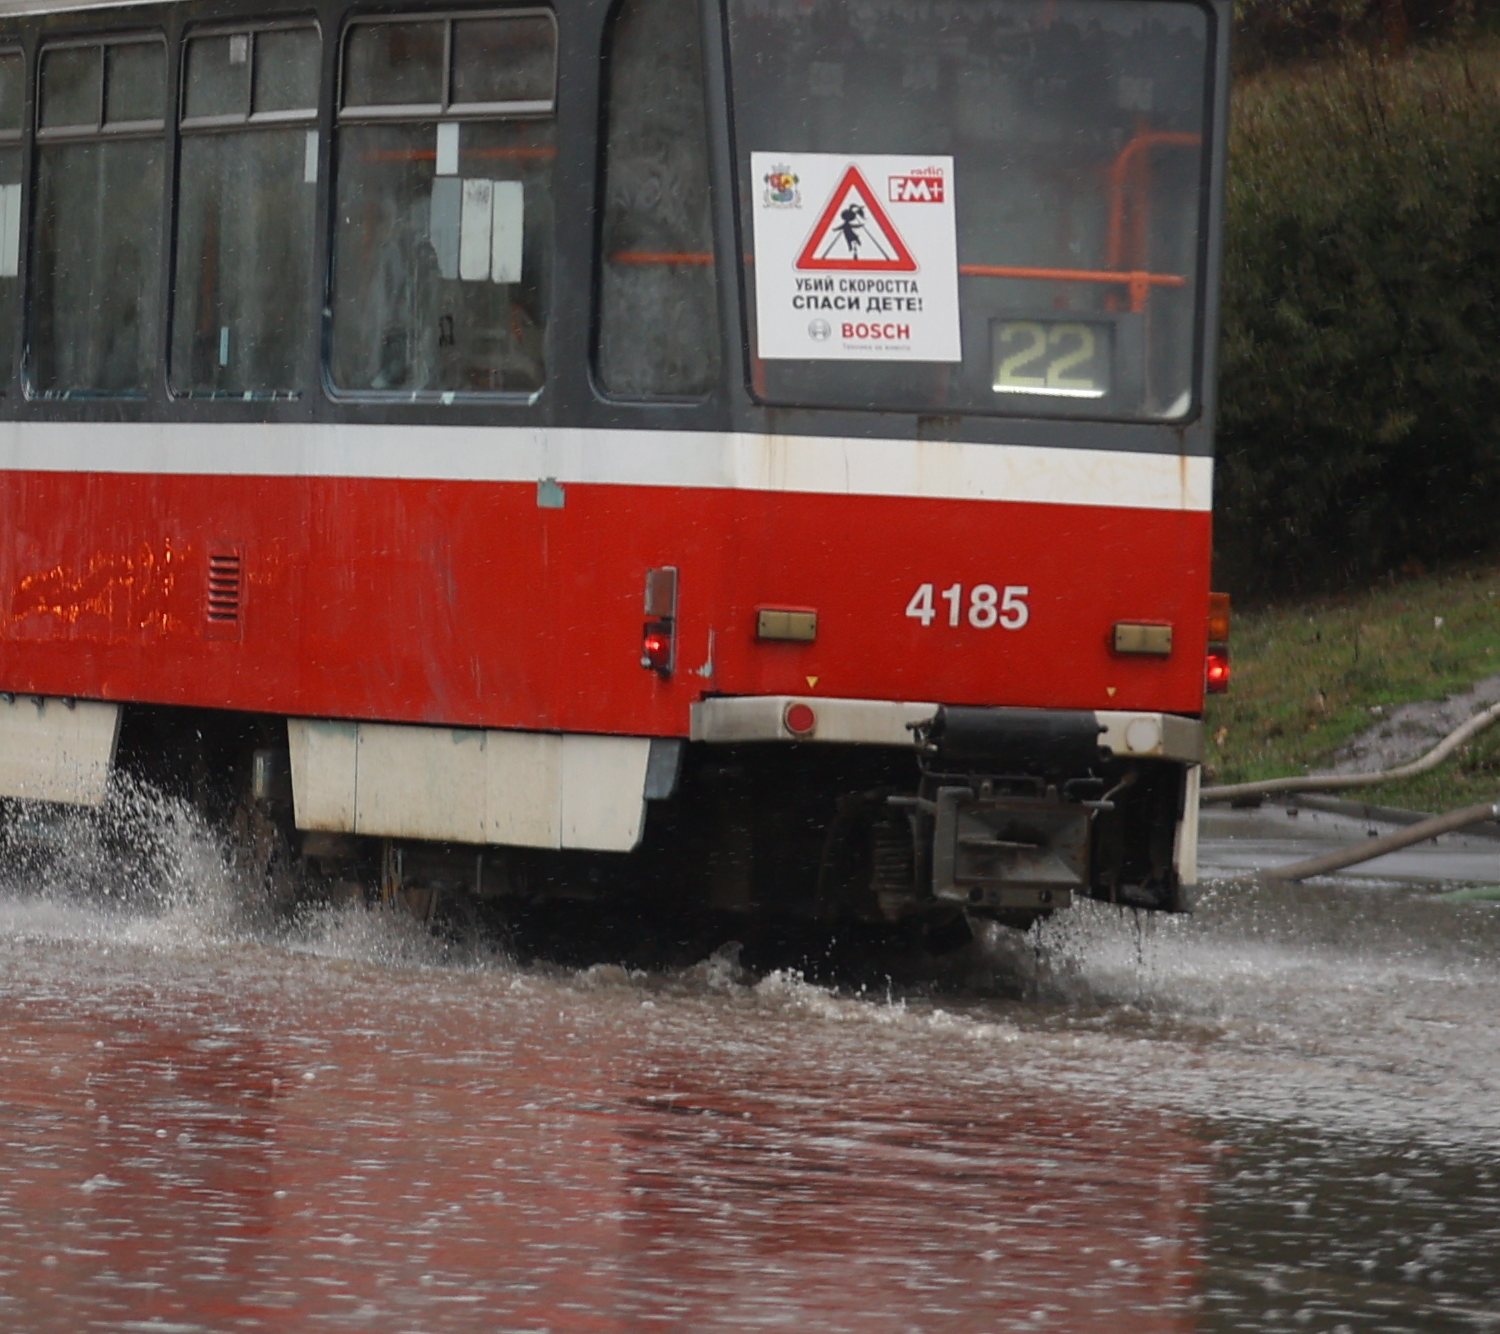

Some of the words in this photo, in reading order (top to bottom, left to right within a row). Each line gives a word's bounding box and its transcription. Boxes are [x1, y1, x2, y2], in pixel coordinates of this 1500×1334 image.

[890, 178, 943, 201] FM+
[795, 275, 834, 292] УБИЙ
[839, 278, 918, 294] СКОРОСТТА
[792, 294, 860, 311] СПАСИ
[866, 296, 923, 313] ДЕТЕ!
[841, 322, 910, 340] BOSCH
[999, 320, 1095, 388] 22
[905, 583, 1030, 630] 4185
